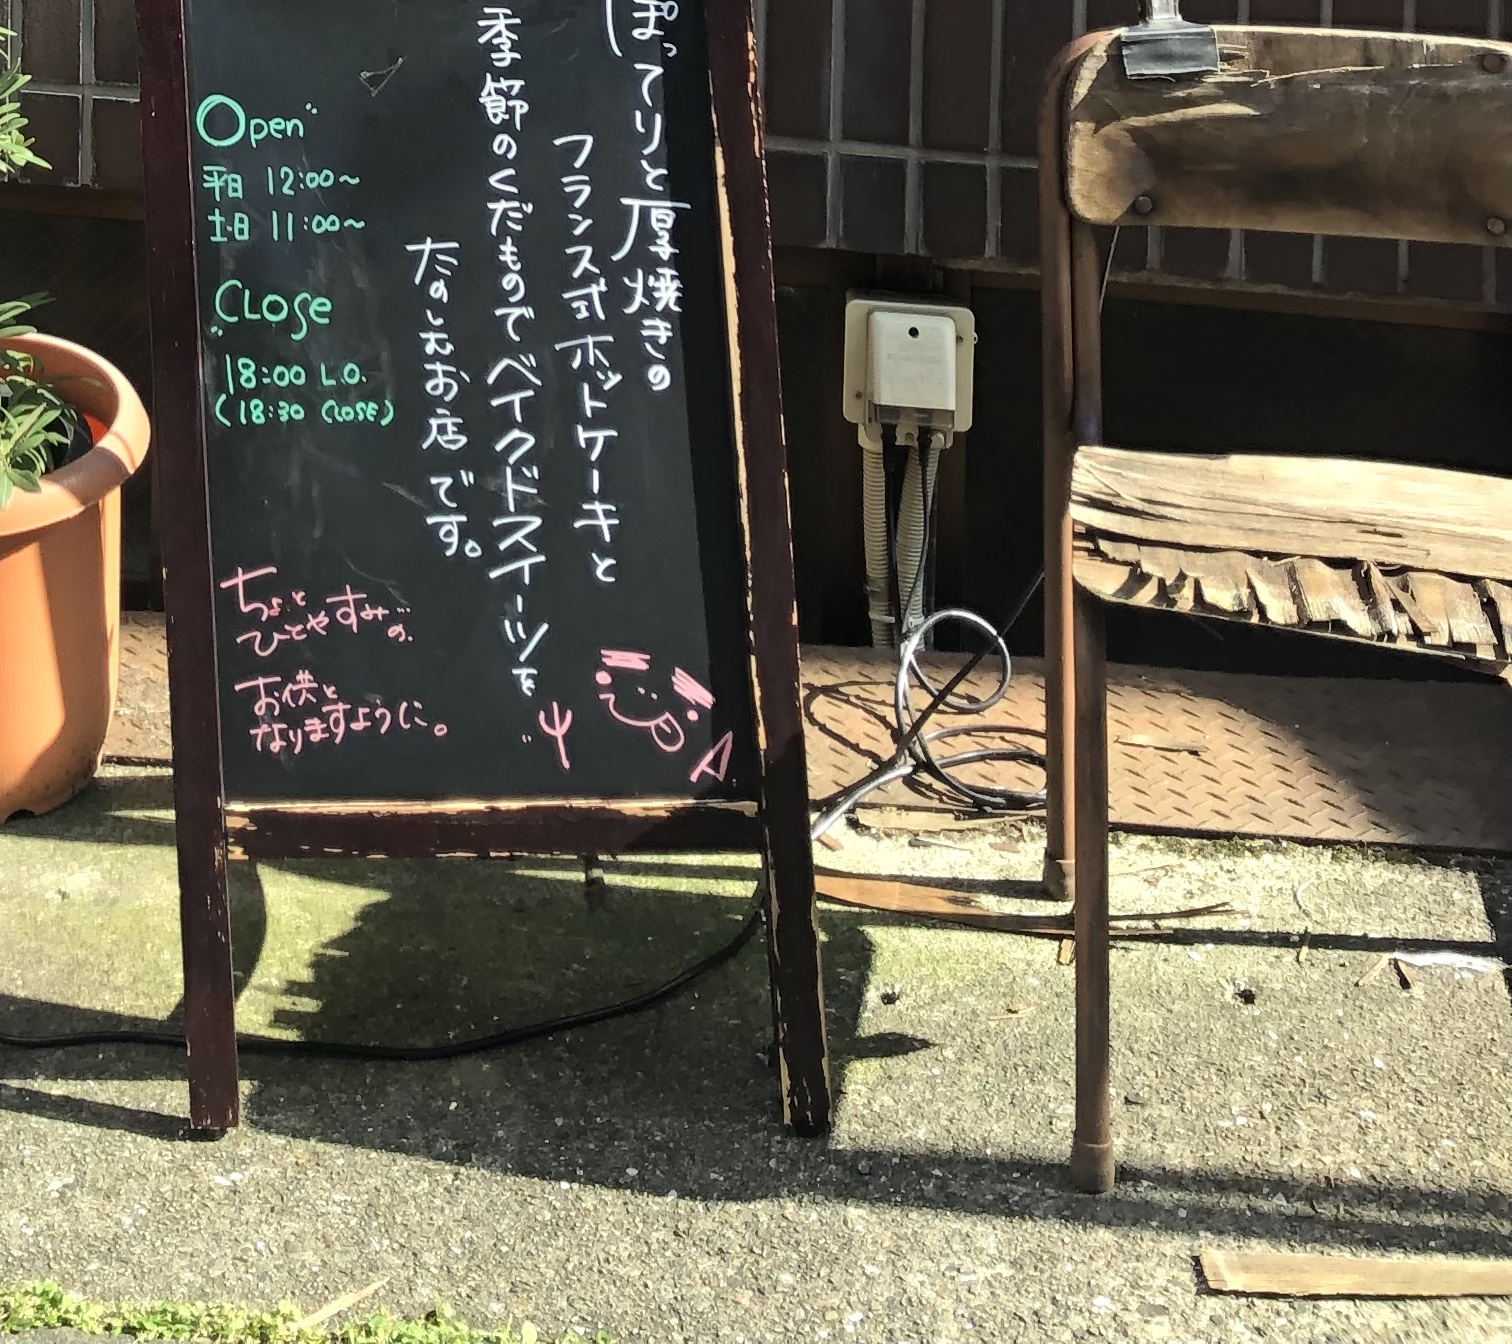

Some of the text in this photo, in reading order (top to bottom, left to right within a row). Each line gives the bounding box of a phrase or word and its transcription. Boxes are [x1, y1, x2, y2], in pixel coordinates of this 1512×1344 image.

[196, 94, 304, 148] Open
[202, 165, 243, 201] 平日
[225, 354, 306, 395] 18:00
[477, 6, 549, 697] 季節のくだものでベイクドスイーツを
[553, 134, 622, 582] フランス式ホットケーキと
